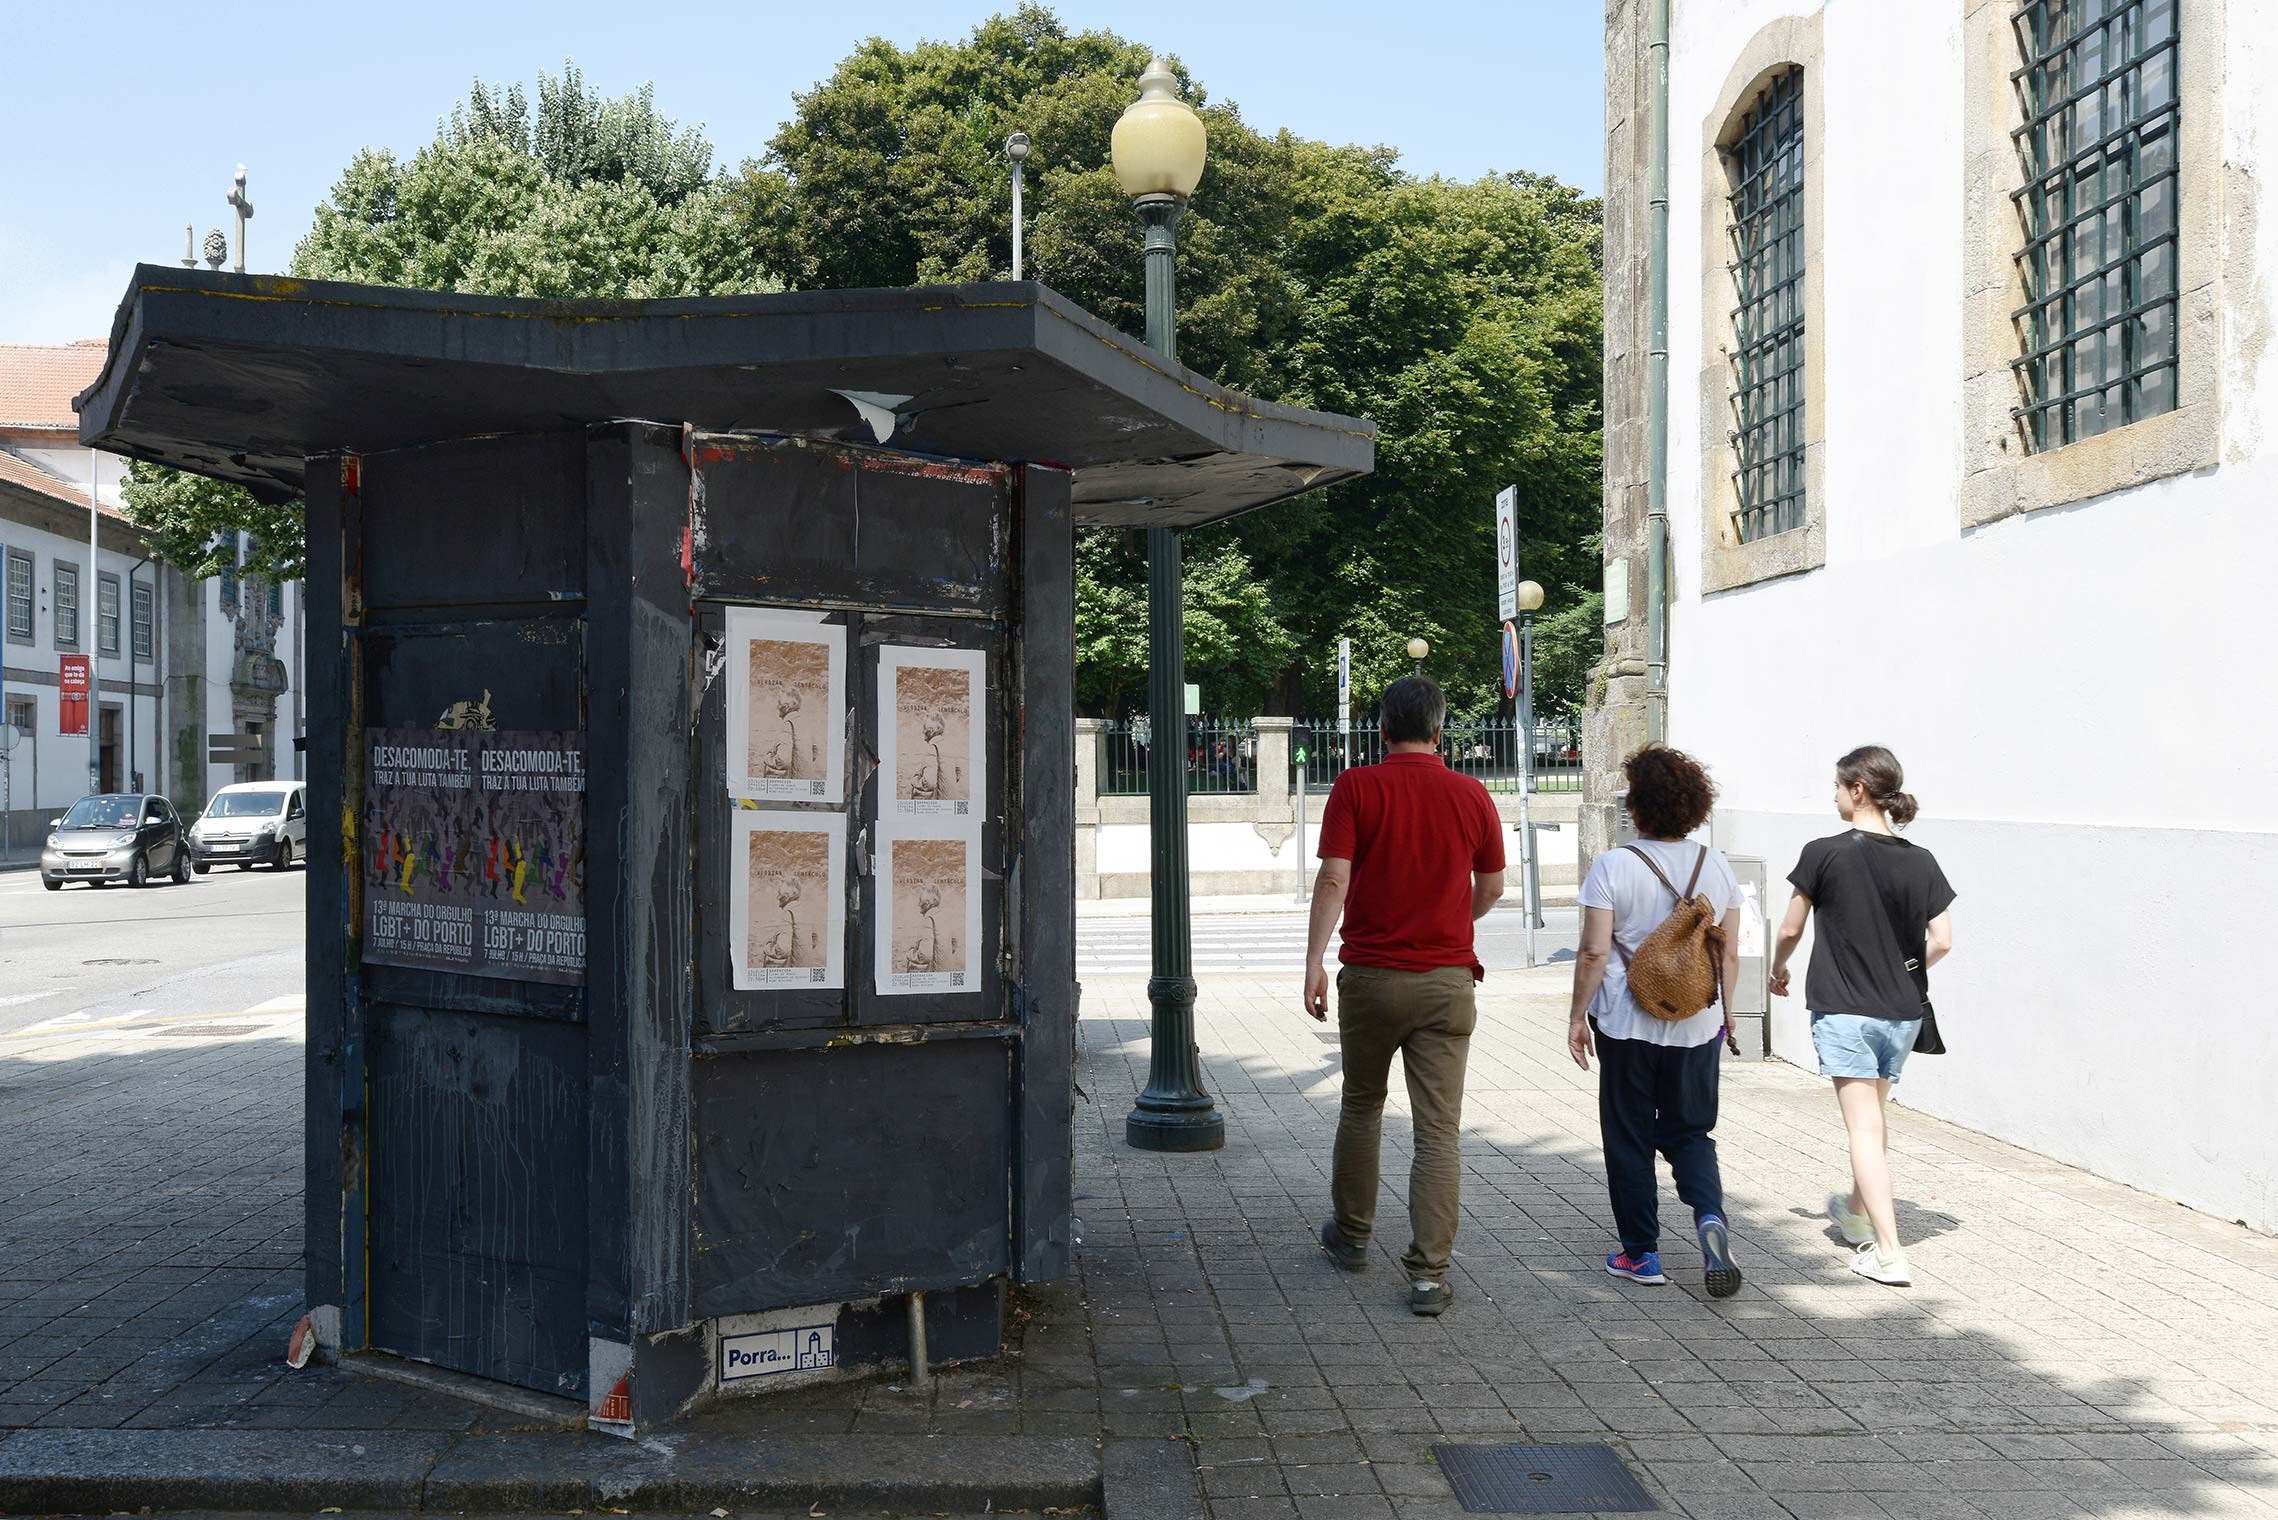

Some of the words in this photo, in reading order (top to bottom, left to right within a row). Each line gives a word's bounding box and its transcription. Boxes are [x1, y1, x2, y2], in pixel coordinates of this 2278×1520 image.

[71, 665, 85, 673] amigo
[374, 745, 472, 773] DESACOMODA-TE,
[481, 749, 586, 777] DESACOMODA-TE,
[374, 770, 393, 785] TRAZ
[394, 771, 400, 785] A
[401, 771, 417, 786] TUA
[418, 772, 437, 787] LUTA
[438, 771, 471, 789] TAMBÉM
[482, 775, 502, 790] TRAZ
[504, 776, 510, 790] A
[511, 776, 528, 791] TUA
[529, 776, 549, 791] LUTA
[550, 773, 585, 792] TAMBÉM
[388, 900, 422, 918] MARCHA
[423, 903, 434, 919] DO
[435, 905, 473, 922] ORGULHO
[484, 910, 498, 925] 13ª
[500, 910, 535, 928] MARCHA
[537, 913, 548, 929] DO
[549, 914, 587, 932] ORGULHO
[373, 915, 411, 938] LGBT+
[414, 918, 430, 941] DO
[433, 920, 473, 946] PORTO
[484, 925, 524, 949] LGBT+
[527, 929, 543, 953] DO
[546, 930, 587, 956] PORTO
[399, 939, 407, 950] 15
[416, 941, 434, 953] PRAÇA
[435, 943, 442, 954] DA
[483, 949, 488, 959] 7
[511, 951, 519, 962] 15
[528, 953, 547, 965] PRAÇA
[547, 954, 555, 965] DA
[728, 1348, 791, 1368] Porra...
